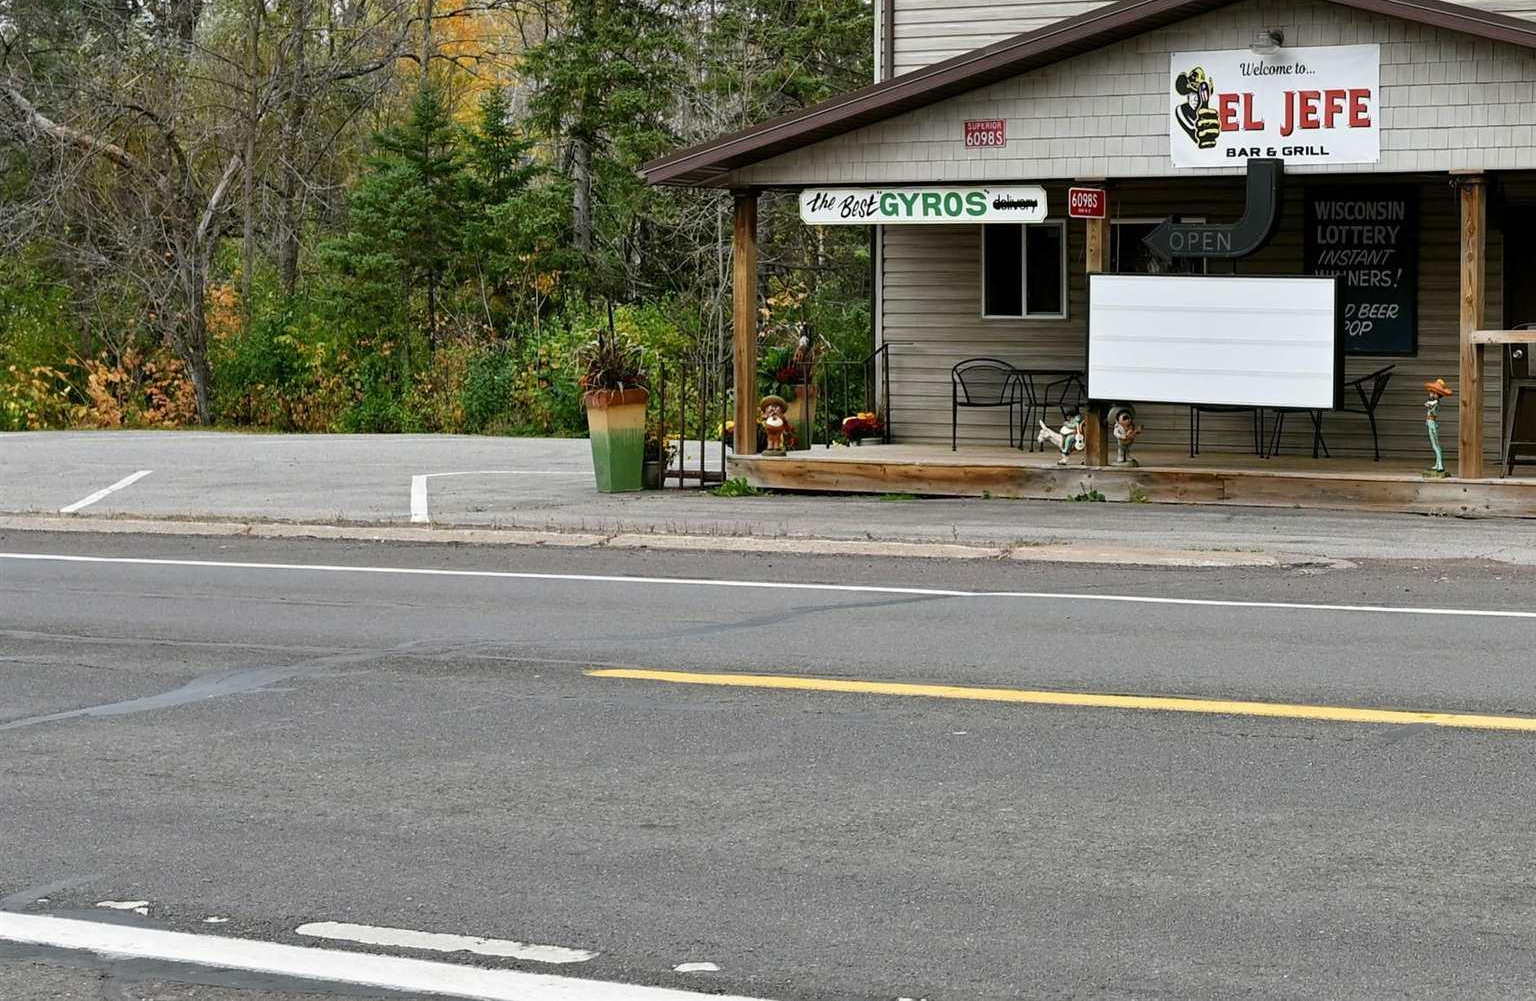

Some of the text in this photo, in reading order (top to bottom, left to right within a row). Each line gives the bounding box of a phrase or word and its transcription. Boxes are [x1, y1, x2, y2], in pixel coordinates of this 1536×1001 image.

[1240, 60, 1293, 77] Welcome
[1217, 88, 1372, 137] EL JEFE
[1226, 145, 1330, 158] BAR & GRILL
[839, 194, 880, 218] Best
[1315, 201, 1405, 221] WISCONSIN
[1169, 231, 1232, 251] OPEN
[1317, 225, 1400, 246] LOTTERY
[1318, 249, 1395, 266] INSTANT
[1315, 268, 1403, 288] NERS!
[1358, 303, 1399, 319] BEER
